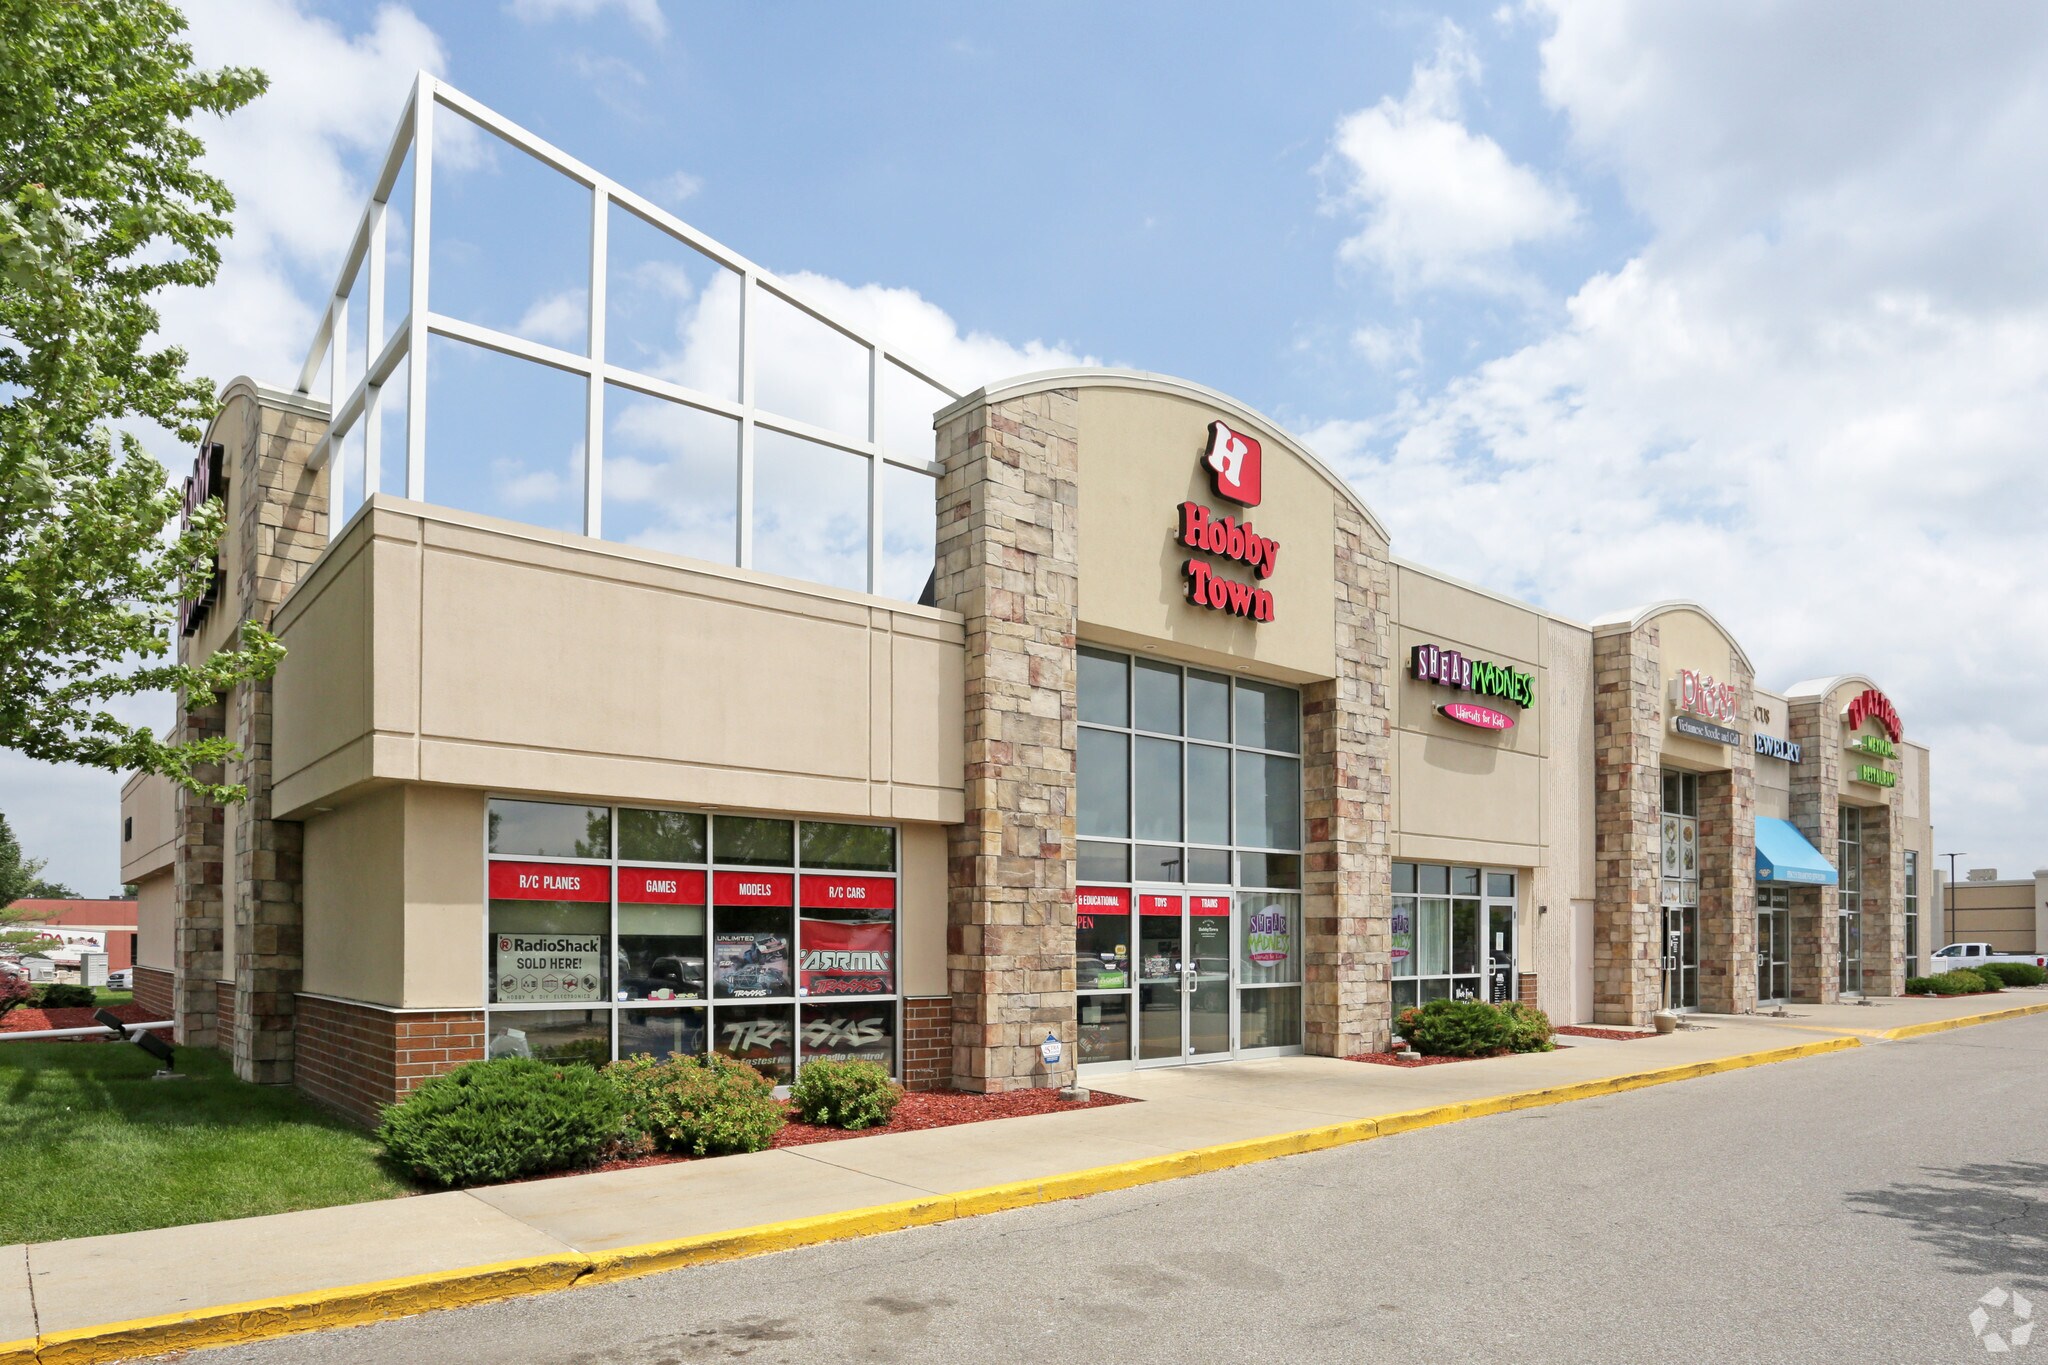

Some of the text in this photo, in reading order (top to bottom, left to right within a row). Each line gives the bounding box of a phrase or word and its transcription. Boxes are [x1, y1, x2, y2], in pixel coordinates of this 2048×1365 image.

[1183, 501, 1280, 579] Hobby
[1188, 558, 1275, 622] Town
[1418, 647, 1535, 709] SHEAR MADNESS
[1455, 704, 1505, 728] Haircuts for Kids
[1755, 732, 1800, 764] EWELRY
[519, 874, 581, 890] R/C PLANES
[646, 879, 677, 894] GAMES
[739, 883, 772, 896] MODELS
[828, 886, 866, 899] R/C CARS
[1083, 895, 1120, 907] EDUCATIONAL
[1154, 897, 1168, 907] TOYS
[1201, 898, 1218, 908] TRAINS
[1077, 916, 1094, 929] PEN
[1250, 913, 1287, 934] SHEAR
[514, 938, 598, 953] RadioShack
[1248, 933, 1290, 953] MADNESS
[517, 957, 582, 970] SOLD HERE!
[733, 989, 767, 997] TRAXXAS
[815, 978, 883, 994] TRAXXAS
[847, 1052, 884, 1061] Cntrol
